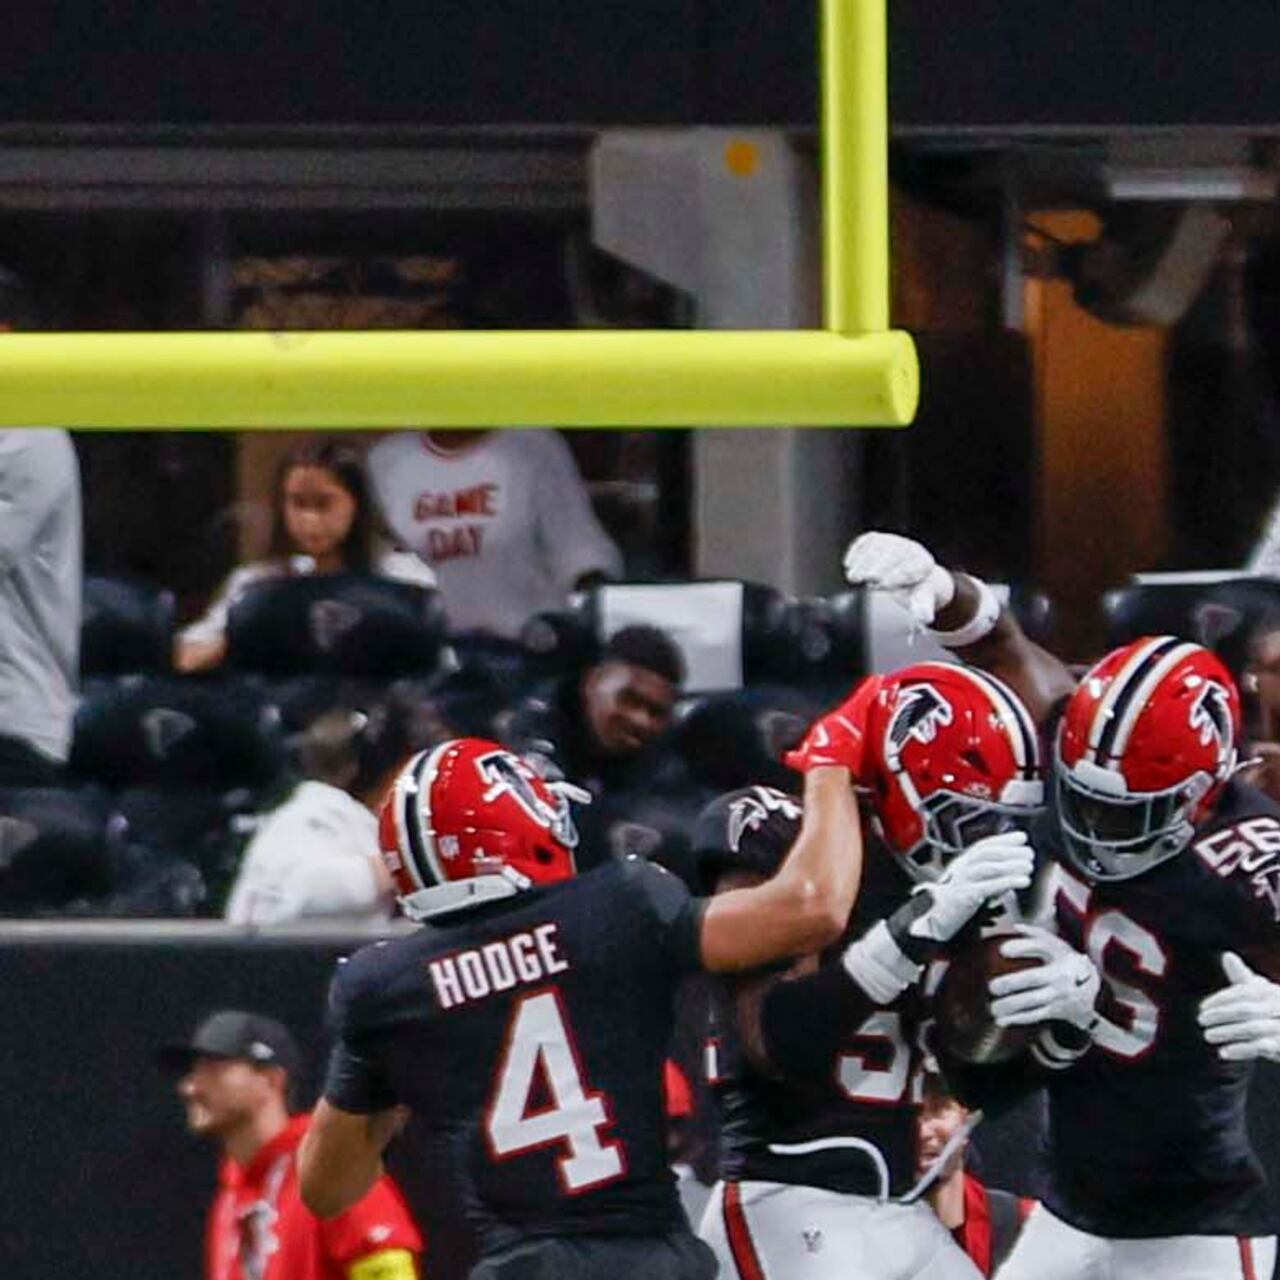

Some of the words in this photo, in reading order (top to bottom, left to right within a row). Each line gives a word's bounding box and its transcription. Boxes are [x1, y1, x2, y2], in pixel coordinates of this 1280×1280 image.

[412, 482, 500, 522] GAME
[427, 525, 484, 562] DAY
[427, 921, 570, 1010] HODGE
[485, 986, 627, 1193] 4
